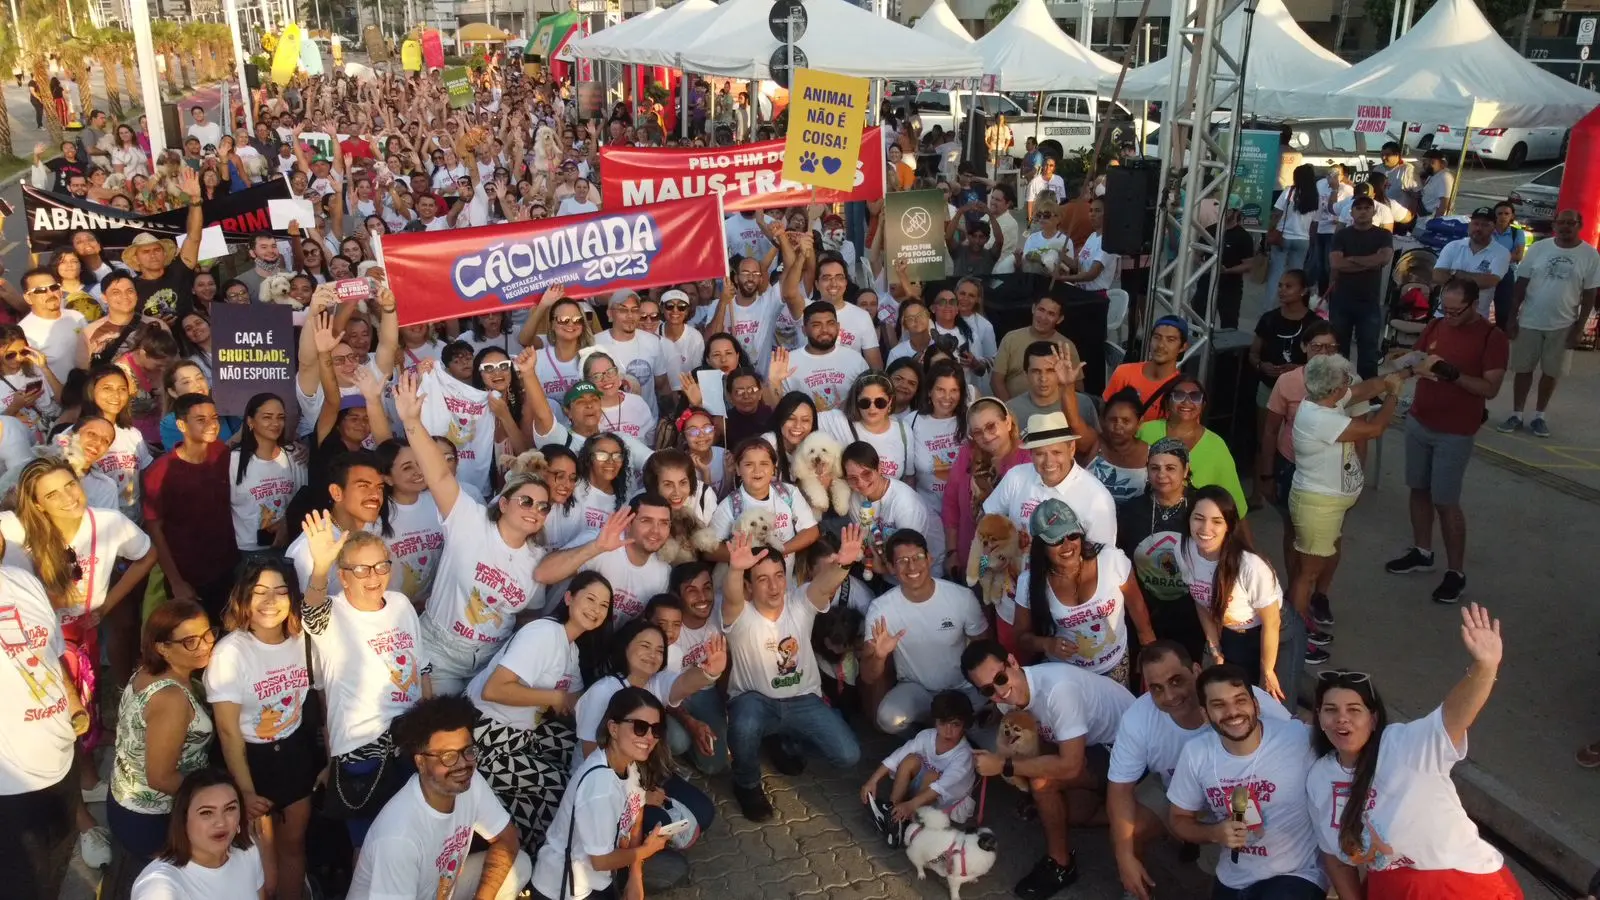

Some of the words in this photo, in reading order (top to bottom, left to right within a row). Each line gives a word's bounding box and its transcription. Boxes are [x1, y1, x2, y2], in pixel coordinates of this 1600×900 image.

[803, 86, 854, 109] ANIMAL
[807, 108, 834, 126] NÃO
[837, 111, 846, 128] É
[1357, 105, 1381, 119] VENDA
[1382, 106, 1392, 119] DE
[1355, 120, 1386, 133] CAMISA
[802, 129, 848, 150] COISA!
[689, 155, 731, 171] PELO
[734, 153, 764, 168] FIM
[454, 214, 657, 298] CÃOMIADA
[582, 252, 649, 281] 2023
[501, 275, 538, 293] FORTALEZA
[505, 285, 530, 300] REGIÃO
[235, 331, 263, 347] CAÇA
[266, 329, 273, 345] É
[218, 348, 290, 365] CRUELDADE,
[219, 364, 241, 380] NÃO
[243, 367, 290, 380] ESPORTE.
